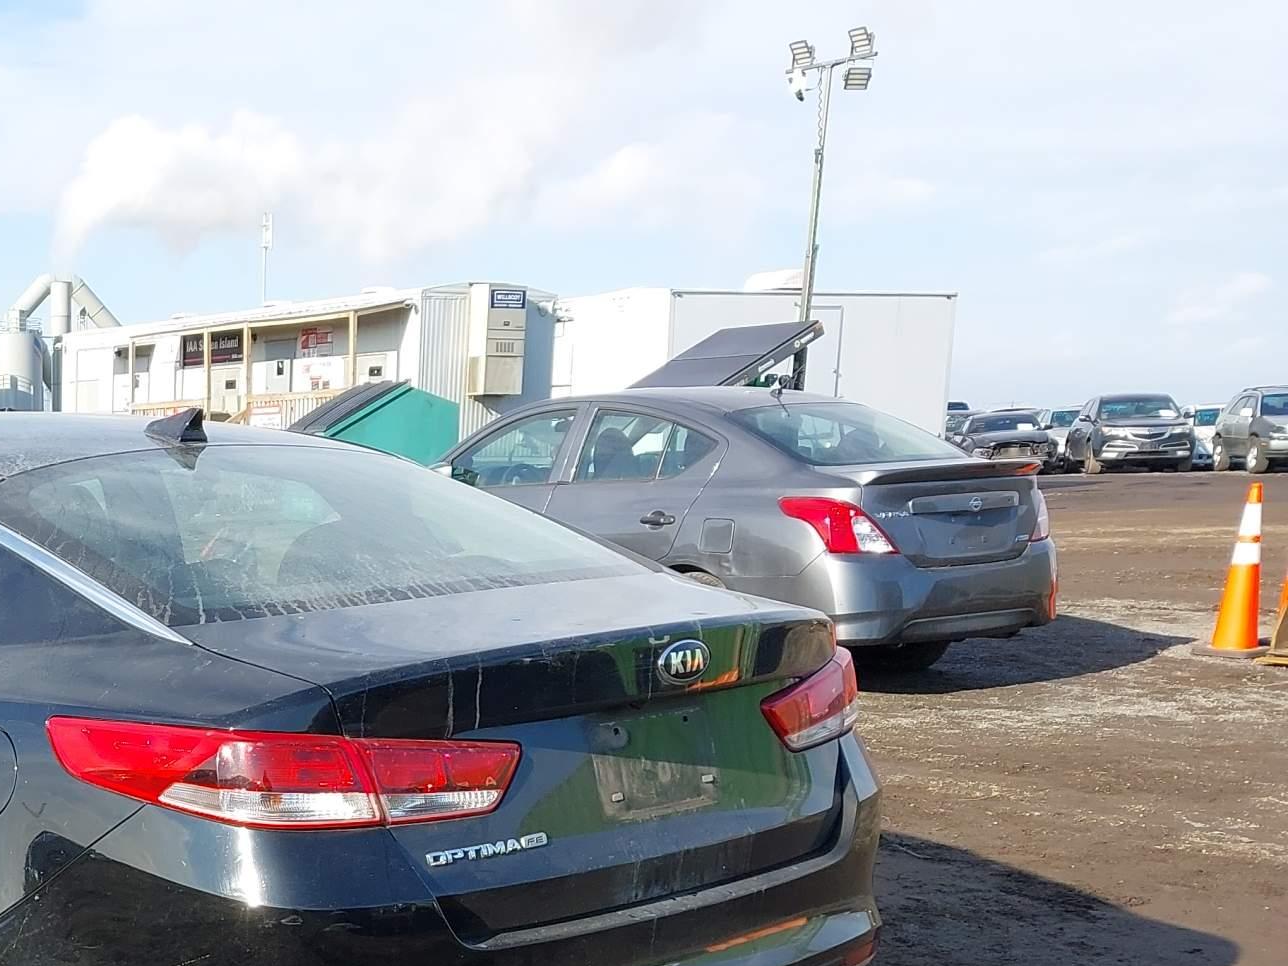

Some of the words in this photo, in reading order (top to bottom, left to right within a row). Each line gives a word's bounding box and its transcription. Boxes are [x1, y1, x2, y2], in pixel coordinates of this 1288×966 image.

[186, 340, 198, 352] IAA
[219, 336, 239, 349] Island
[670, 648, 704, 675] KIA
[425, 839, 522, 867] OPTIMA
